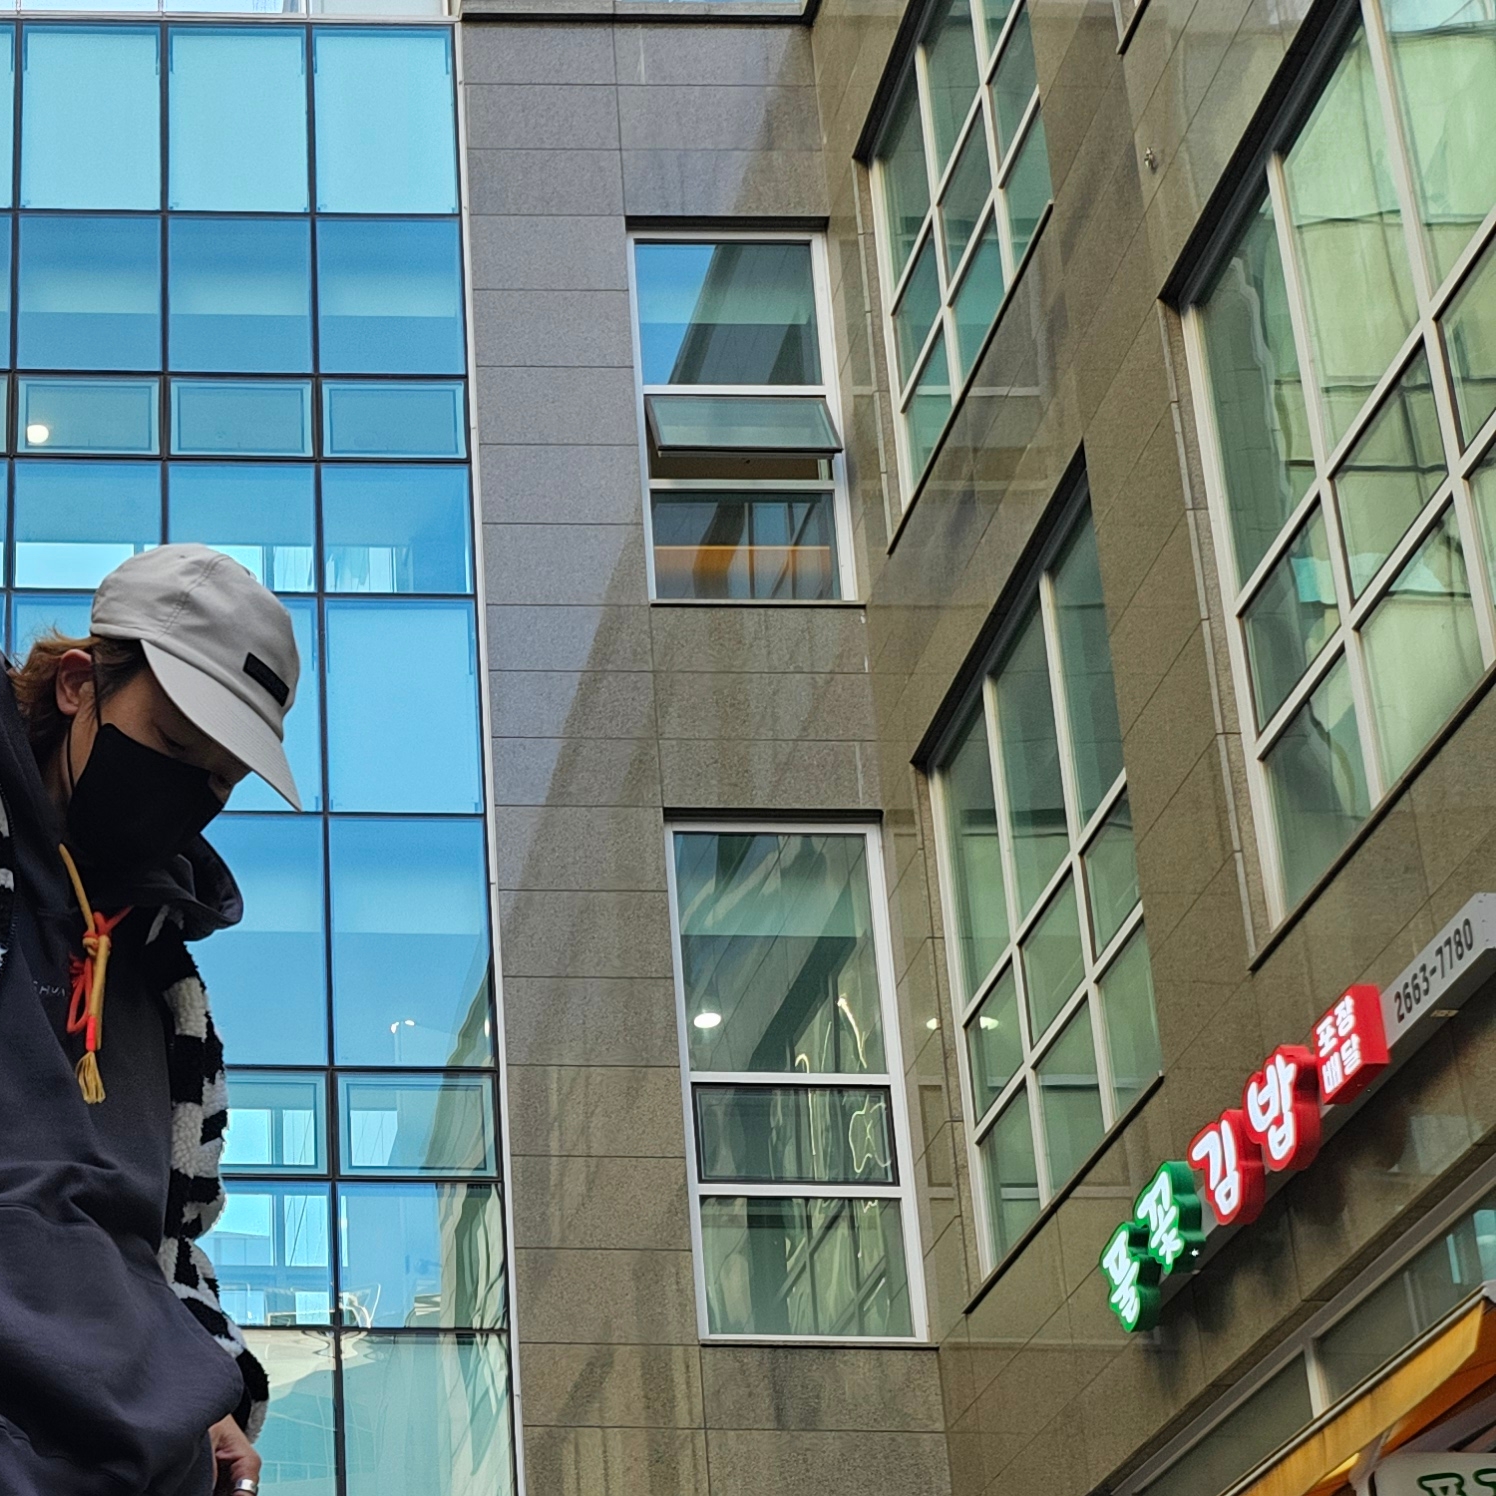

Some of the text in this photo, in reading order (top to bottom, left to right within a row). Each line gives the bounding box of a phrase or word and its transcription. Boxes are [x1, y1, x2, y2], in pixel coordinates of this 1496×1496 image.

[1394, 917, 1474, 1023] 2663-7780
[1316, 995, 1354, 1057] 포장
[1322, 1033, 1362, 1094] 배달
